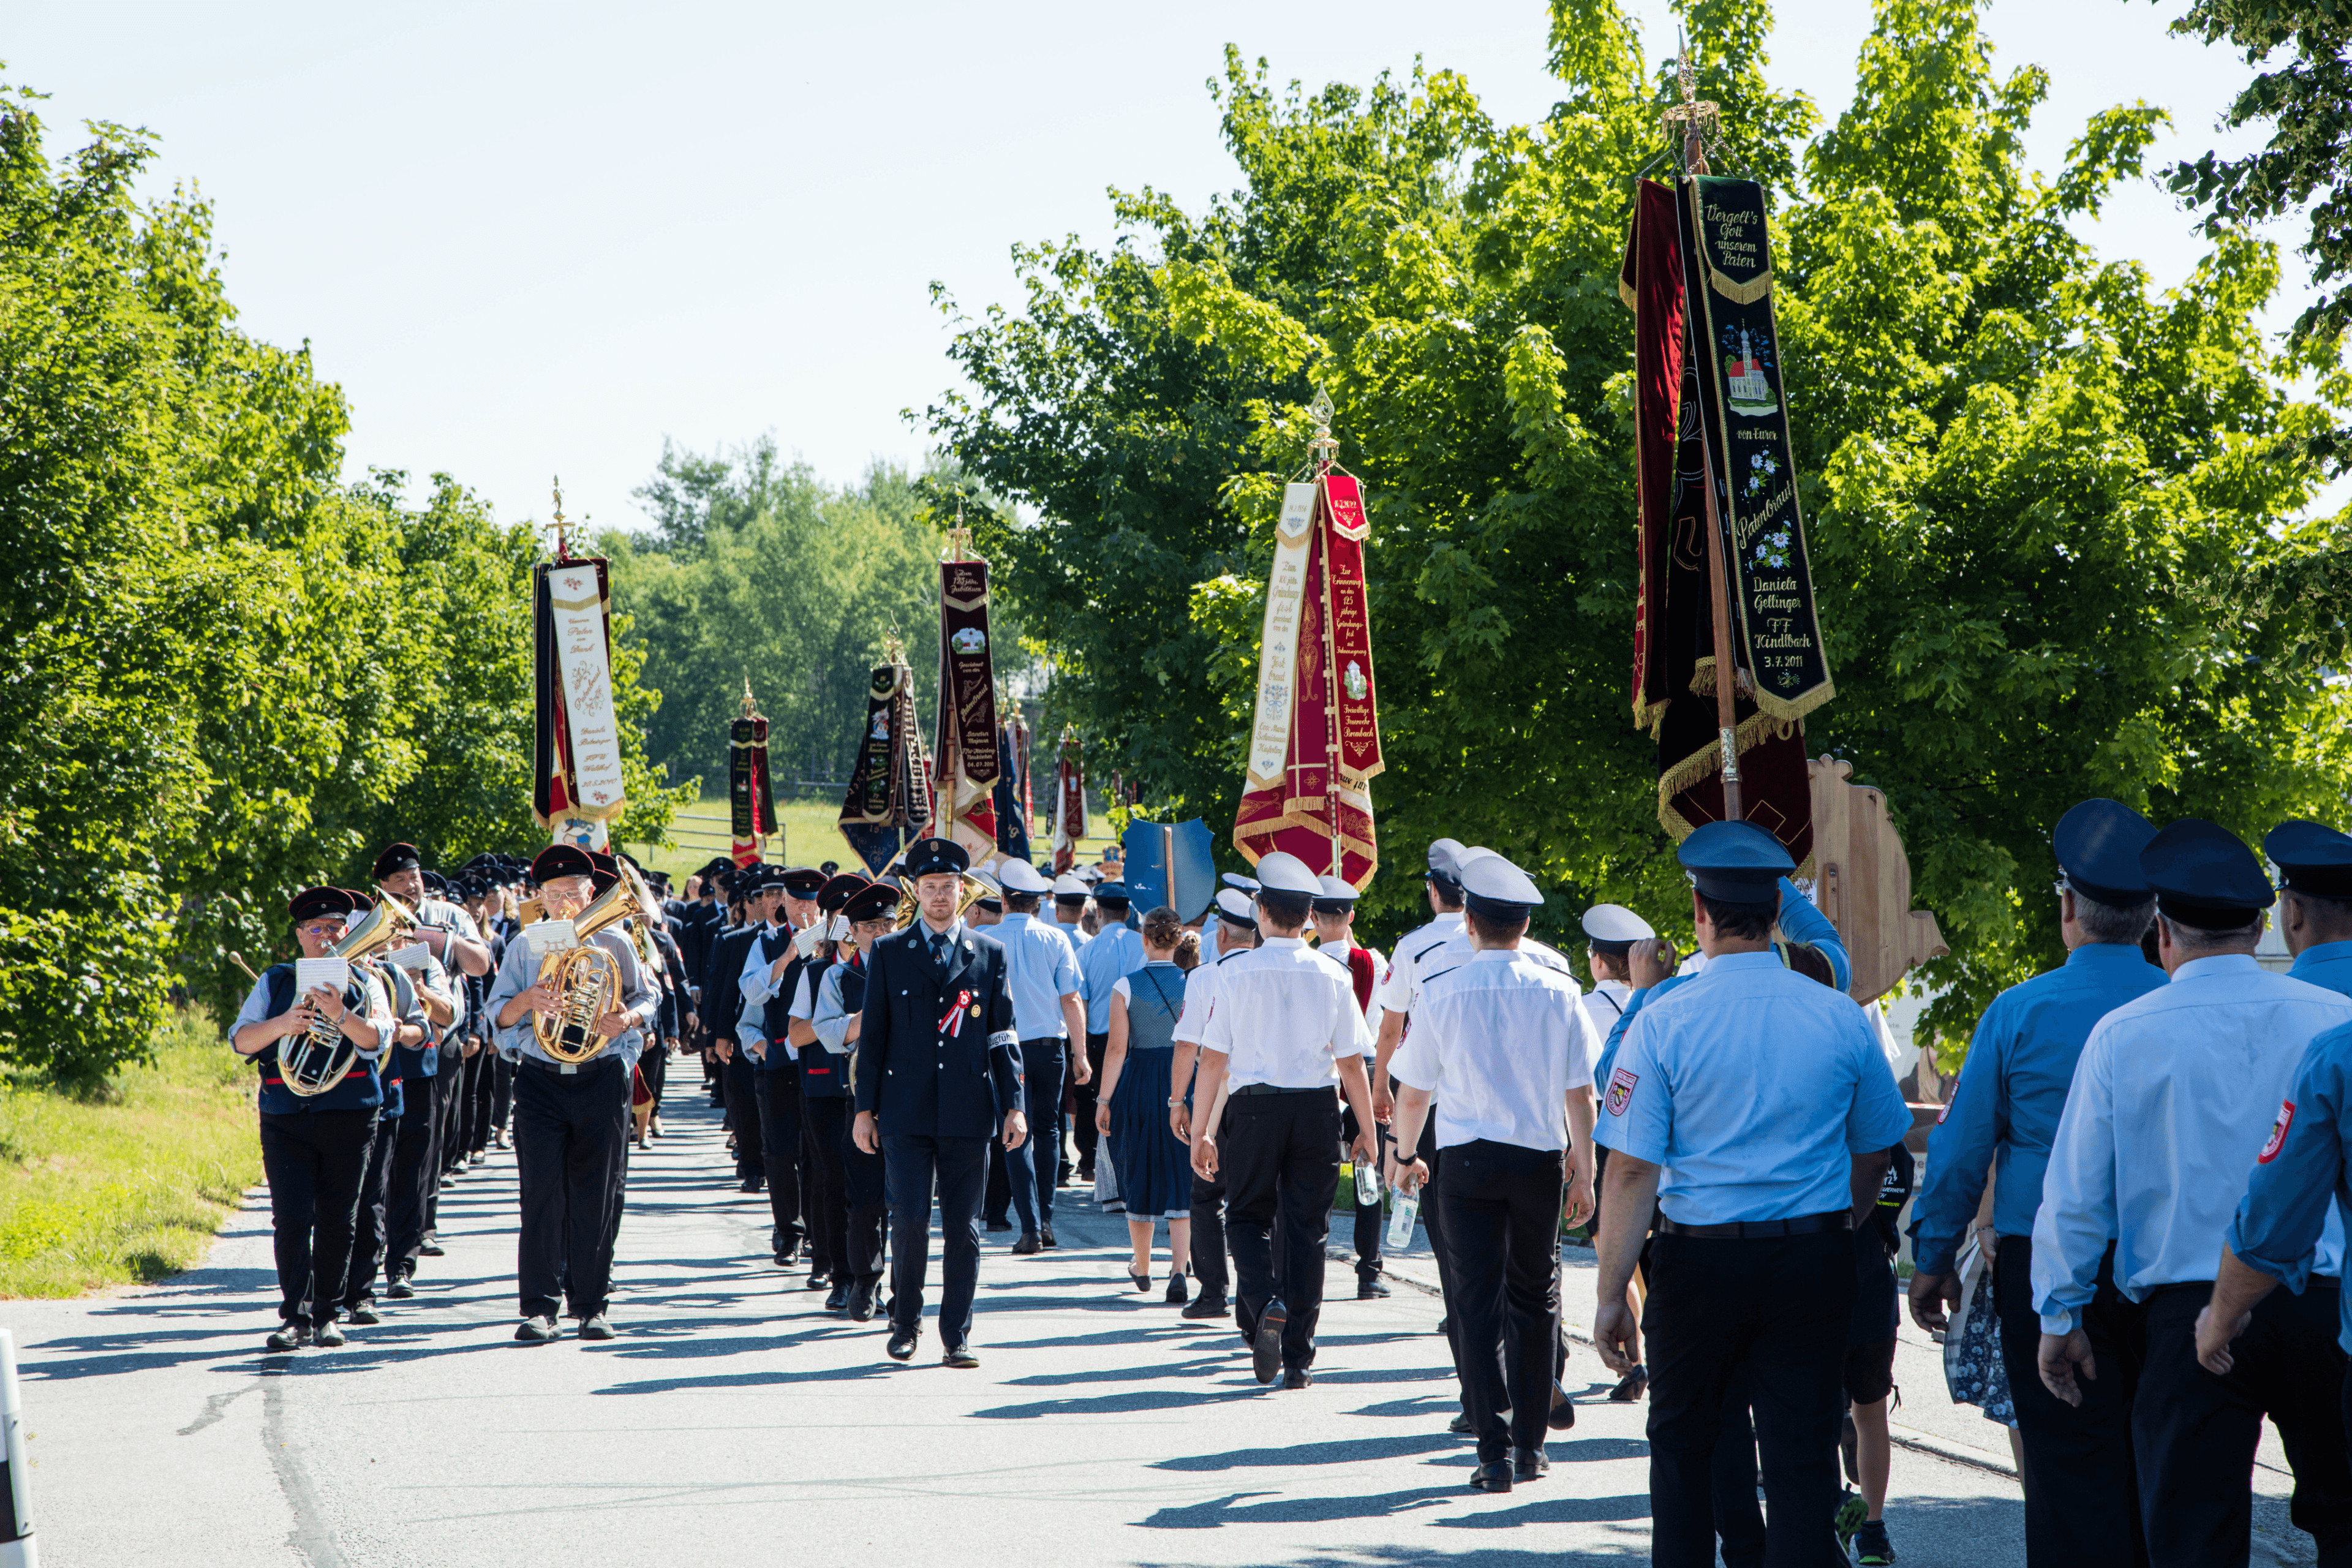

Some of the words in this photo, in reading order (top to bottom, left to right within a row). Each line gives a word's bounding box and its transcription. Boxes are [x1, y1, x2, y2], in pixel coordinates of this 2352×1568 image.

[1705, 203, 1758, 227] Vergelt's
[1720, 223, 1743, 240] Gott
[1715, 240, 1757, 253] unserem
[1722, 250, 1756, 268] Paten
[1736, 429, 1752, 440] von
[1736, 480, 1792, 549] Patenbraut
[955, 568, 973, 576] Zum
[1339, 564, 1351, 575] Zur
[1331, 574, 1362, 589] Erinnerung
[1753, 576, 1796, 592] Daniela
[950, 585, 982, 594] Jubiläum
[1343, 596, 1353, 605] 125
[1754, 594, 1801, 614] Gellinger
[1340, 606, 1357, 618] jährige
[567, 627, 593, 636] Paten
[1766, 617, 1793, 633] FF
[1754, 633, 1811, 649] Kindlbach
[1764, 655, 1803, 668] 3.7.2011
[960, 683, 989, 723] Patenbraut
[1343, 704, 1370, 717] Freiwillige
[1344, 715, 1370, 725] Feuerwehr
[1343, 726, 1374, 737] Brombach
